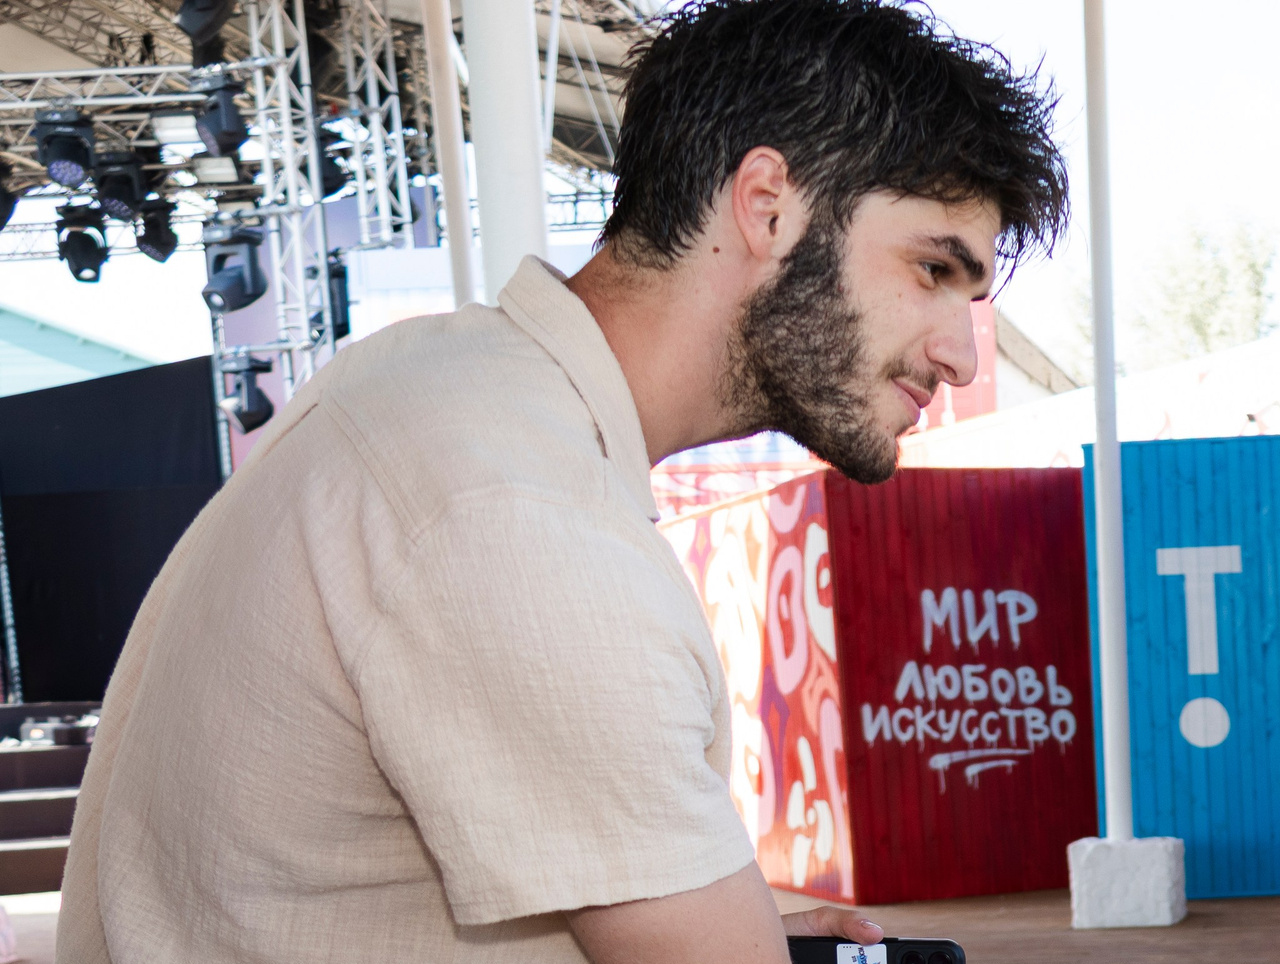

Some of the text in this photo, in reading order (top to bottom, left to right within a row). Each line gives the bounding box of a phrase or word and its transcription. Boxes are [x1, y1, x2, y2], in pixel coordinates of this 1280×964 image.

[920, 587, 1037, 650] МИР
[894, 661, 1073, 706] ЛЮБОВЬ
[861, 703, 1076, 744] ИСКУССТВО
